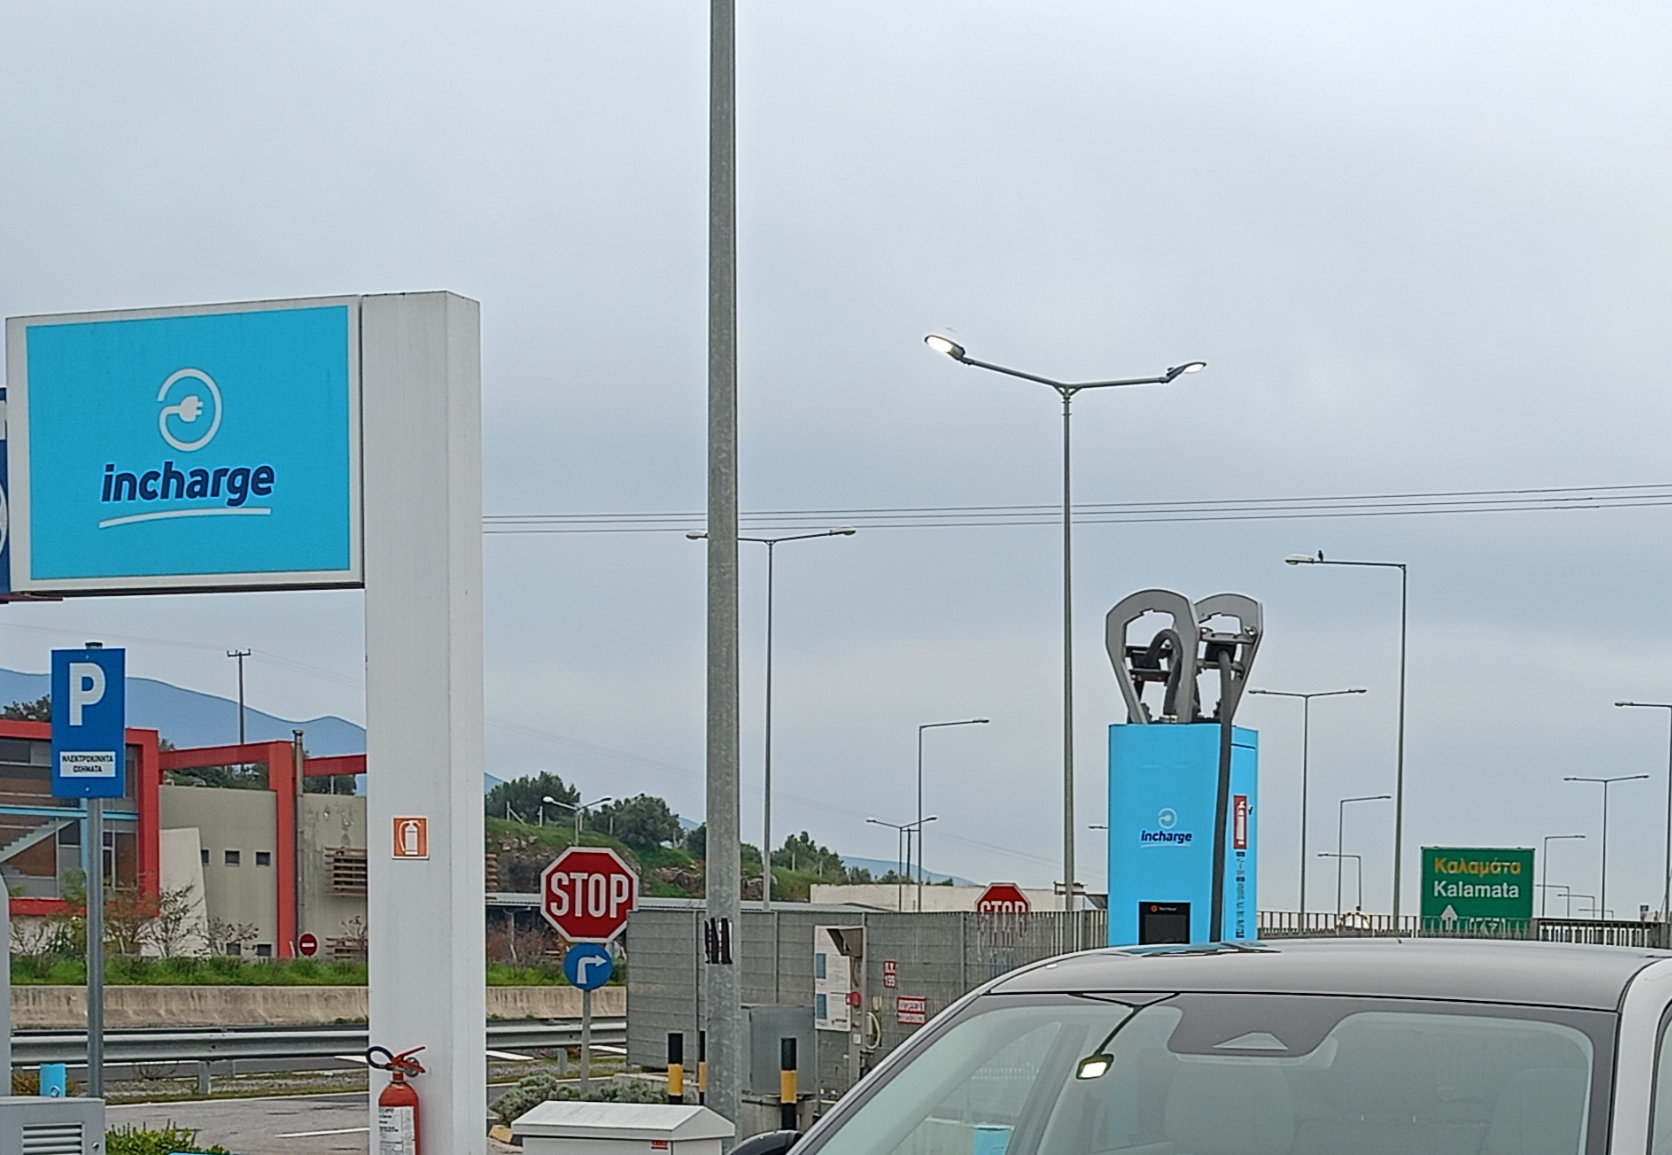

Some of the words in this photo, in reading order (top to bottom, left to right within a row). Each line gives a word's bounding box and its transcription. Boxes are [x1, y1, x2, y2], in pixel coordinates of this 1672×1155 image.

[101, 461, 275, 507] incharge
[69, 662, 106, 726] P
[1141, 830, 1193, 844] incharge
[1434, 857, 1521, 878] Καλαμάτα
[550, 872, 629, 918] STOP
[1433, 881, 1519, 897] Kalamata
